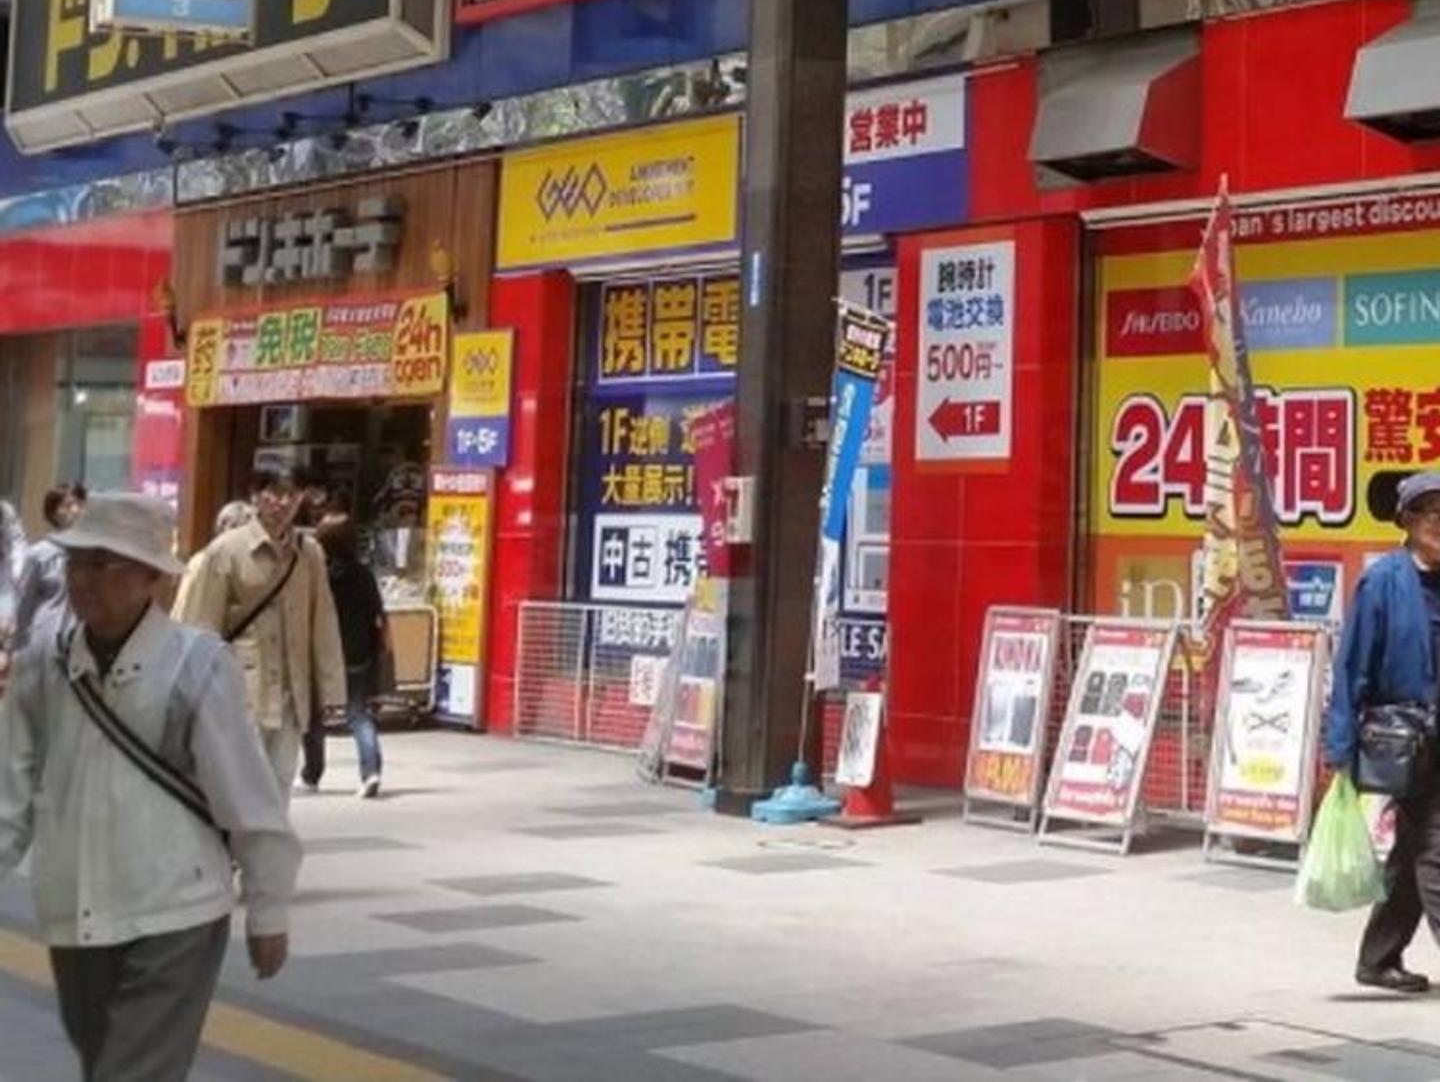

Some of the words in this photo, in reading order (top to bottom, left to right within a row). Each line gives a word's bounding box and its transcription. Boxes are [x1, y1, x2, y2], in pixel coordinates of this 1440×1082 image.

[1288, 202, 1364, 232] largest
[864, 273, 893, 310] 1F
[937, 257, 996, 293] 腕時計
[962, 404, 985, 433] 1F
